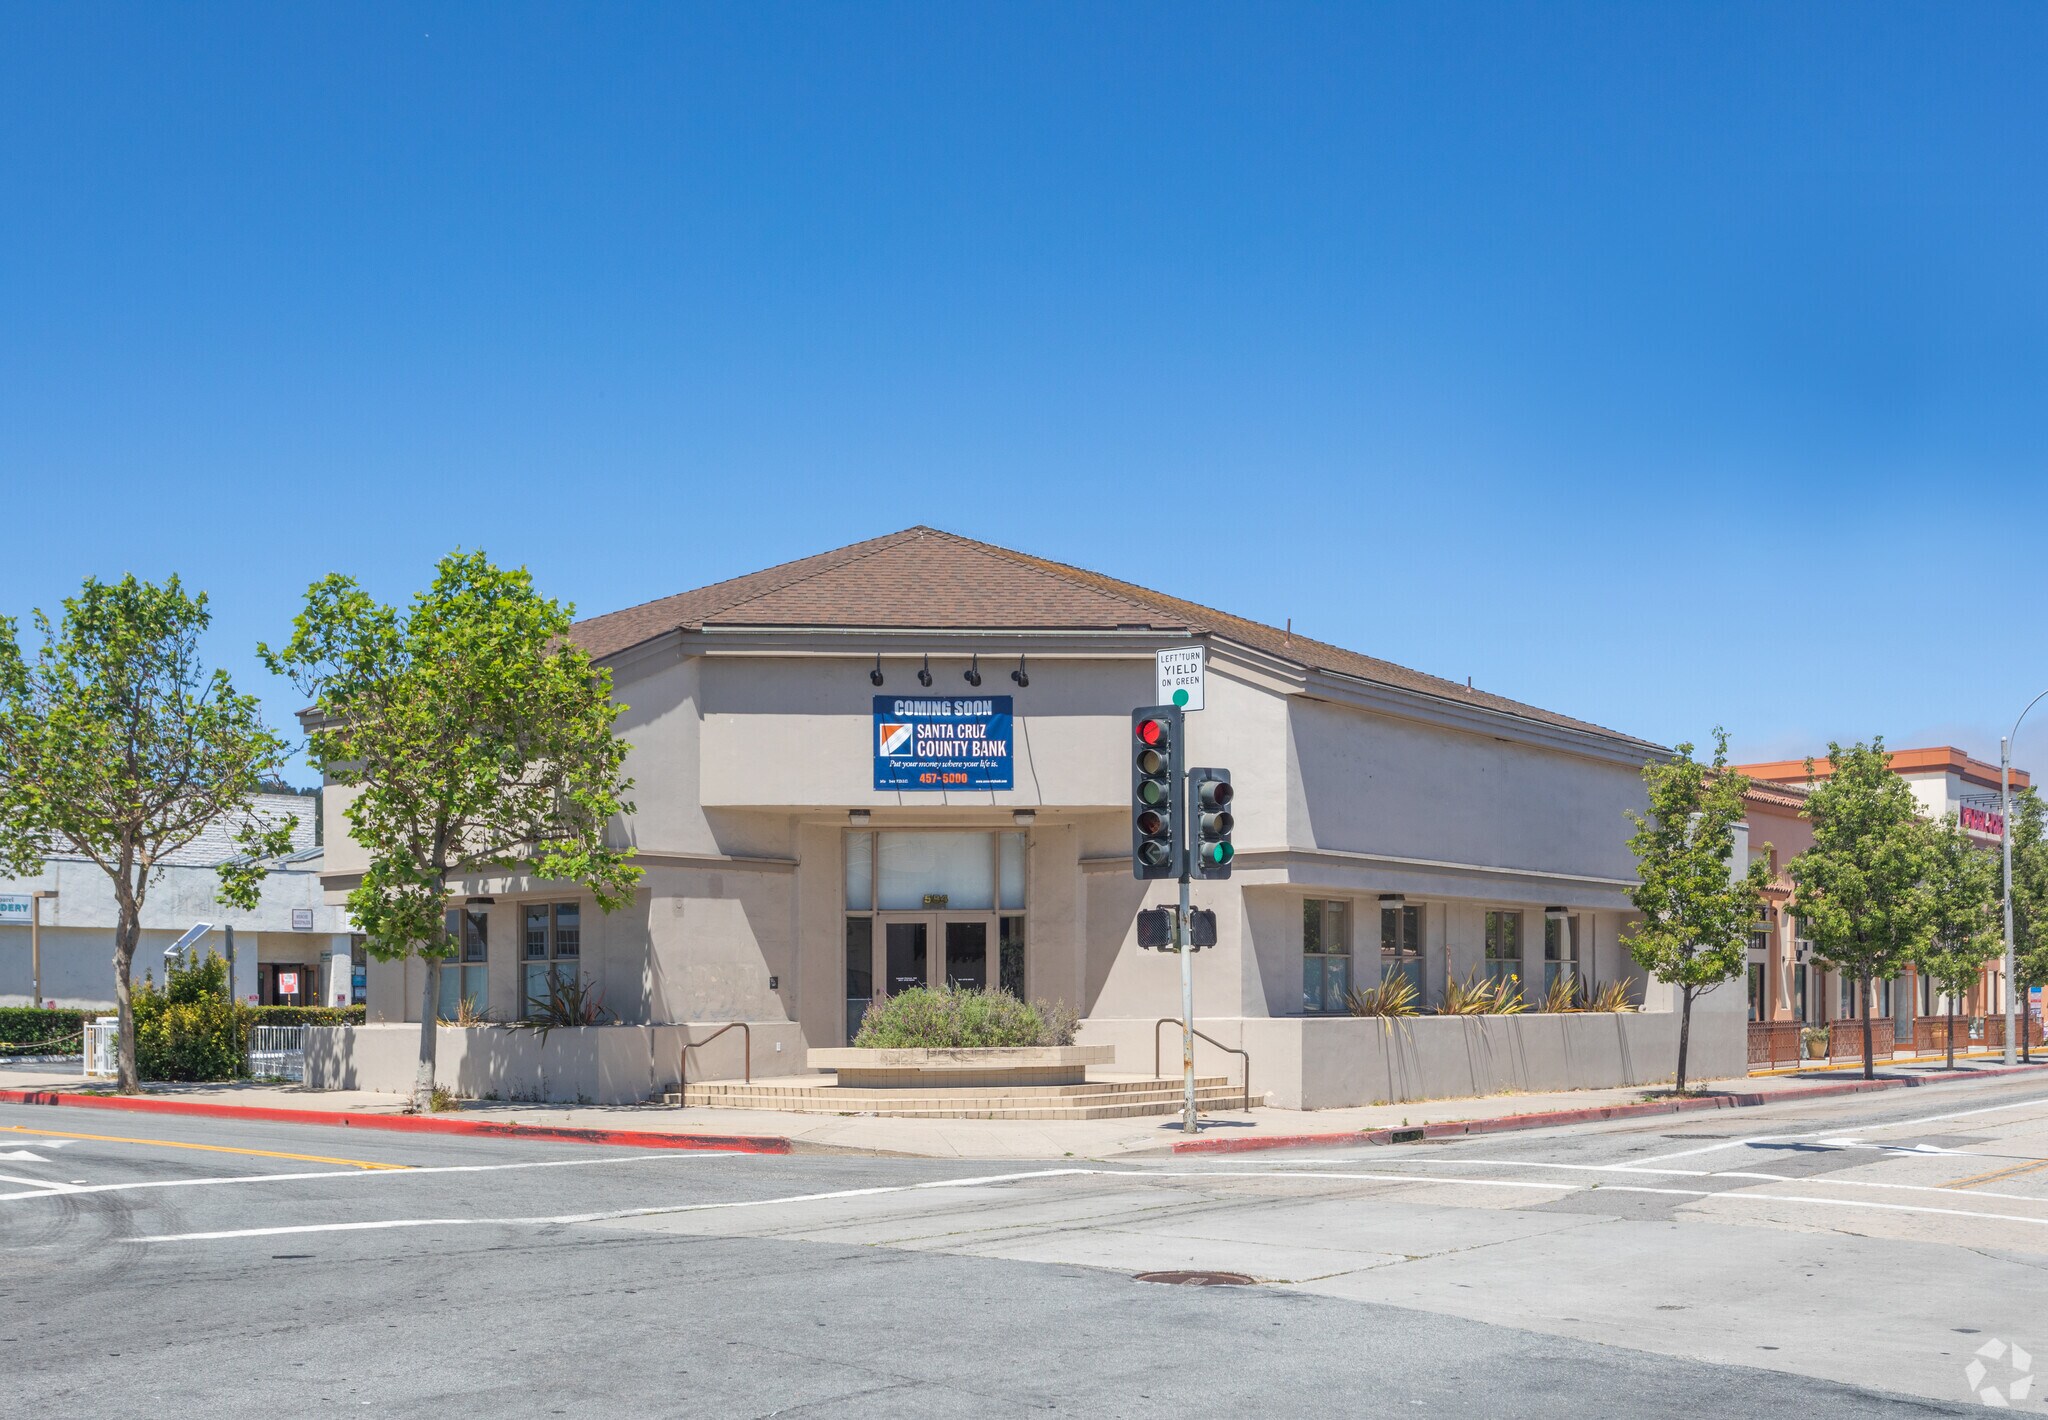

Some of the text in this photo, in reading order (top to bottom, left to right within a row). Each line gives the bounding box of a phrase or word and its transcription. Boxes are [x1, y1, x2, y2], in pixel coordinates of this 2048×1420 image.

[1160, 652, 1200, 663] LEFT TURN
[1164, 663, 1198, 675] YIELD
[1161, 676, 1200, 687] ON GREEN
[894, 700, 993, 716] COMING SOON
[917, 724, 987, 738] SANTA CRUZ
[917, 740, 1007, 757] COUNTY BANK
[889, 759, 901, 767] Put
[902, 761, 918, 769] your
[918, 761, 941, 769] money
[942, 759, 963, 768] where
[963, 761, 979, 769] your
[980, 759, 991, 769] life
[919, 773, 968, 784] 457-5000
